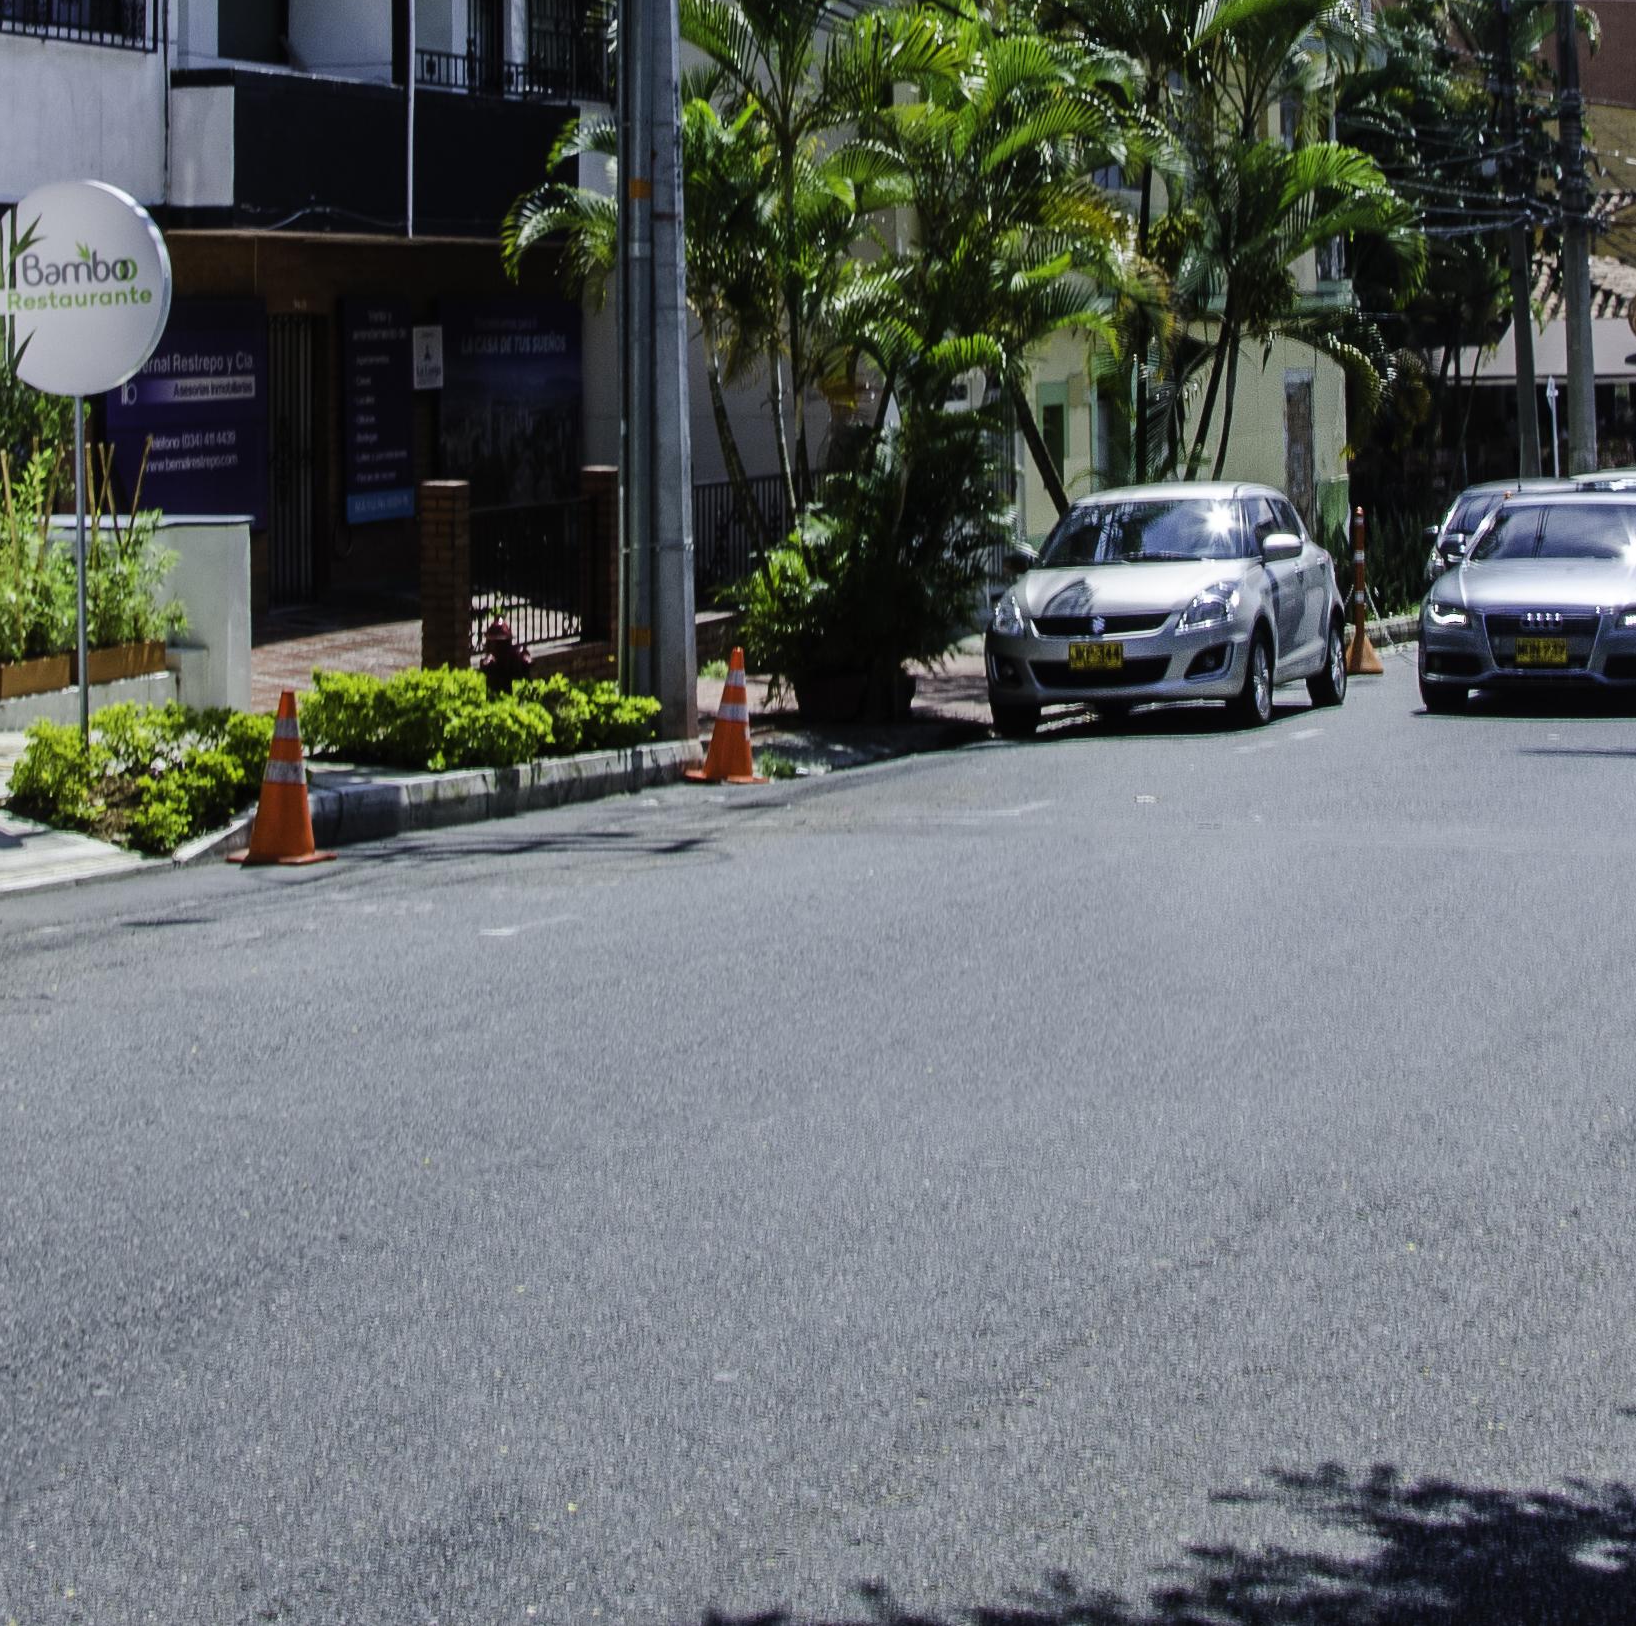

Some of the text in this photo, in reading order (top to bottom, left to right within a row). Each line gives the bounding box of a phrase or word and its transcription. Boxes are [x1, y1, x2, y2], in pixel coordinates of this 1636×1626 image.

[7, 287, 153, 311] Restaurante
[173, 350, 224, 374] Restrepo
[226, 356, 233, 374] y
